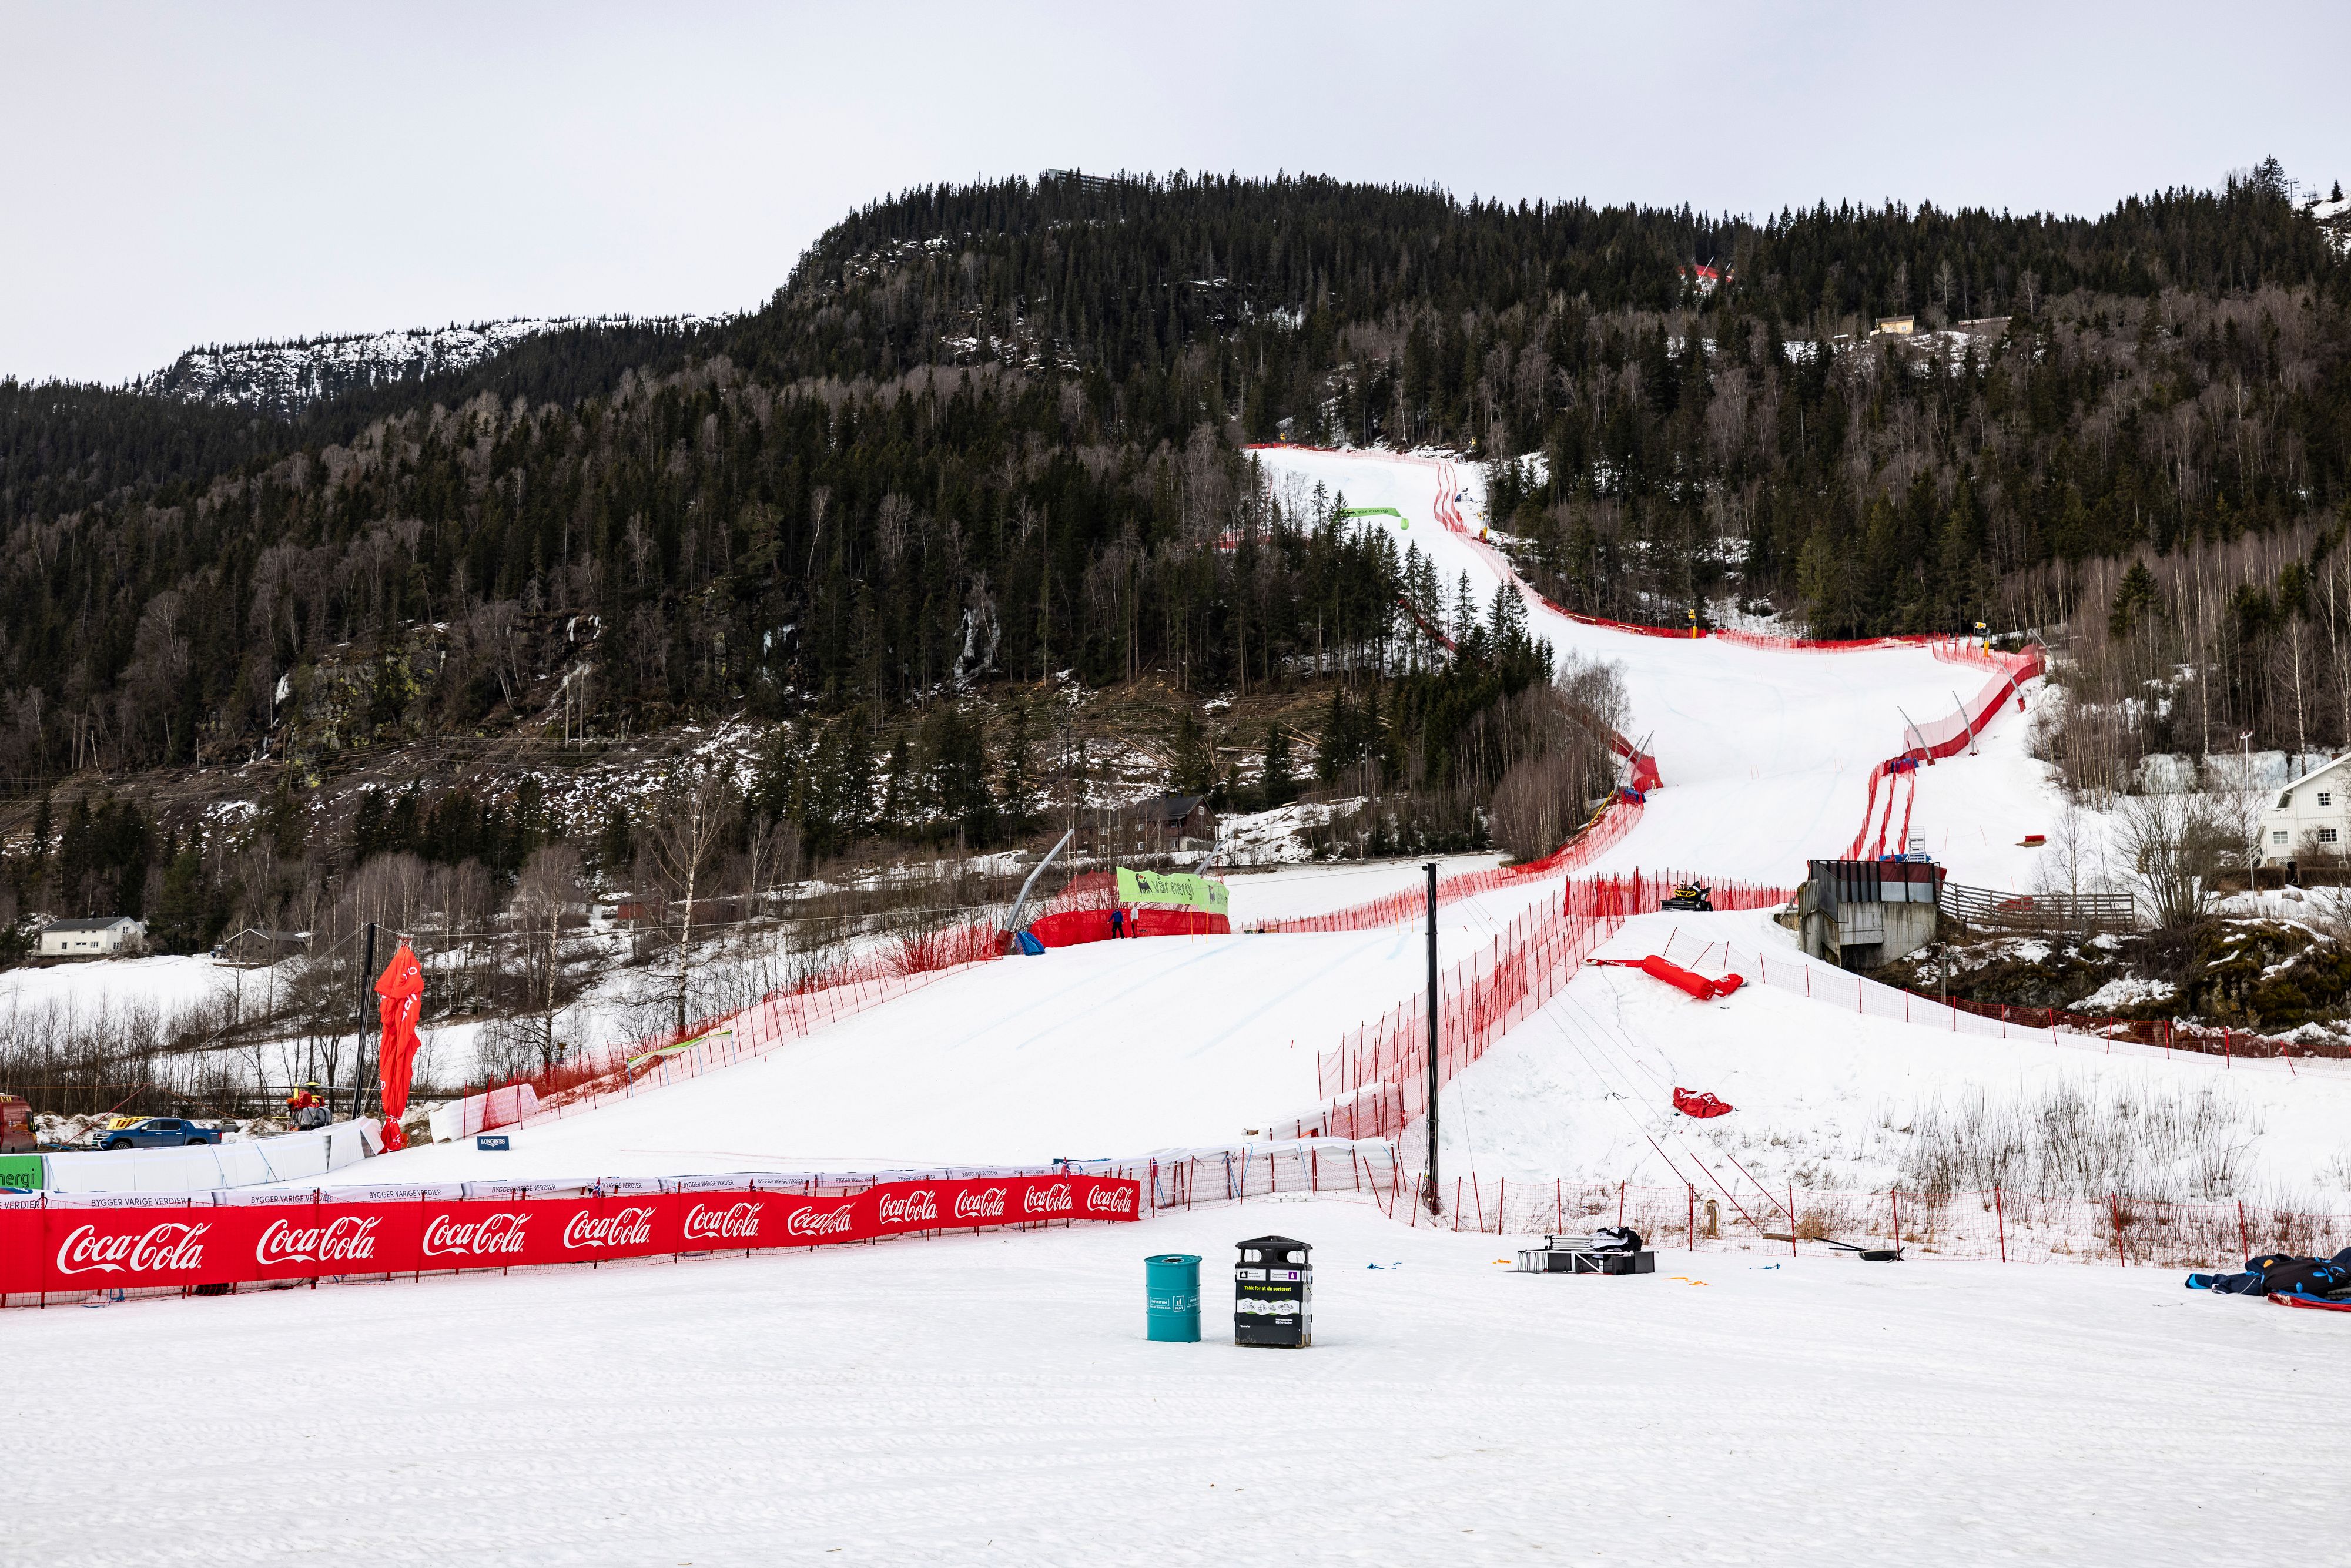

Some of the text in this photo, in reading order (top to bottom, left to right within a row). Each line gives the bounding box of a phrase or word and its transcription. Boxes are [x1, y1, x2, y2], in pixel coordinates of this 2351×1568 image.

[1151, 875, 1194, 900] vår energi
[5, 1201, 40, 1209] VERDIER
[251, 1195, 279, 1204] BYGGER
[879, 1190, 937, 1225] Coca-Cola
[955, 1188, 1008, 1218] Coca-Cola
[1024, 1184, 1073, 1214] Coca-Cola
[1087, 1185, 1134, 1213] Coca-Cola
[423, 1213, 533, 1256] Coca-Cola
[564, 1207, 657, 1248] Coca-Cola
[684, 1202, 765, 1239] Coca-Cola
[788, 1201, 857, 1236] Coca-Cola
[57, 1223, 212, 1274] Coca-Cola
[256, 1217, 383, 1265] Coca-Cola
